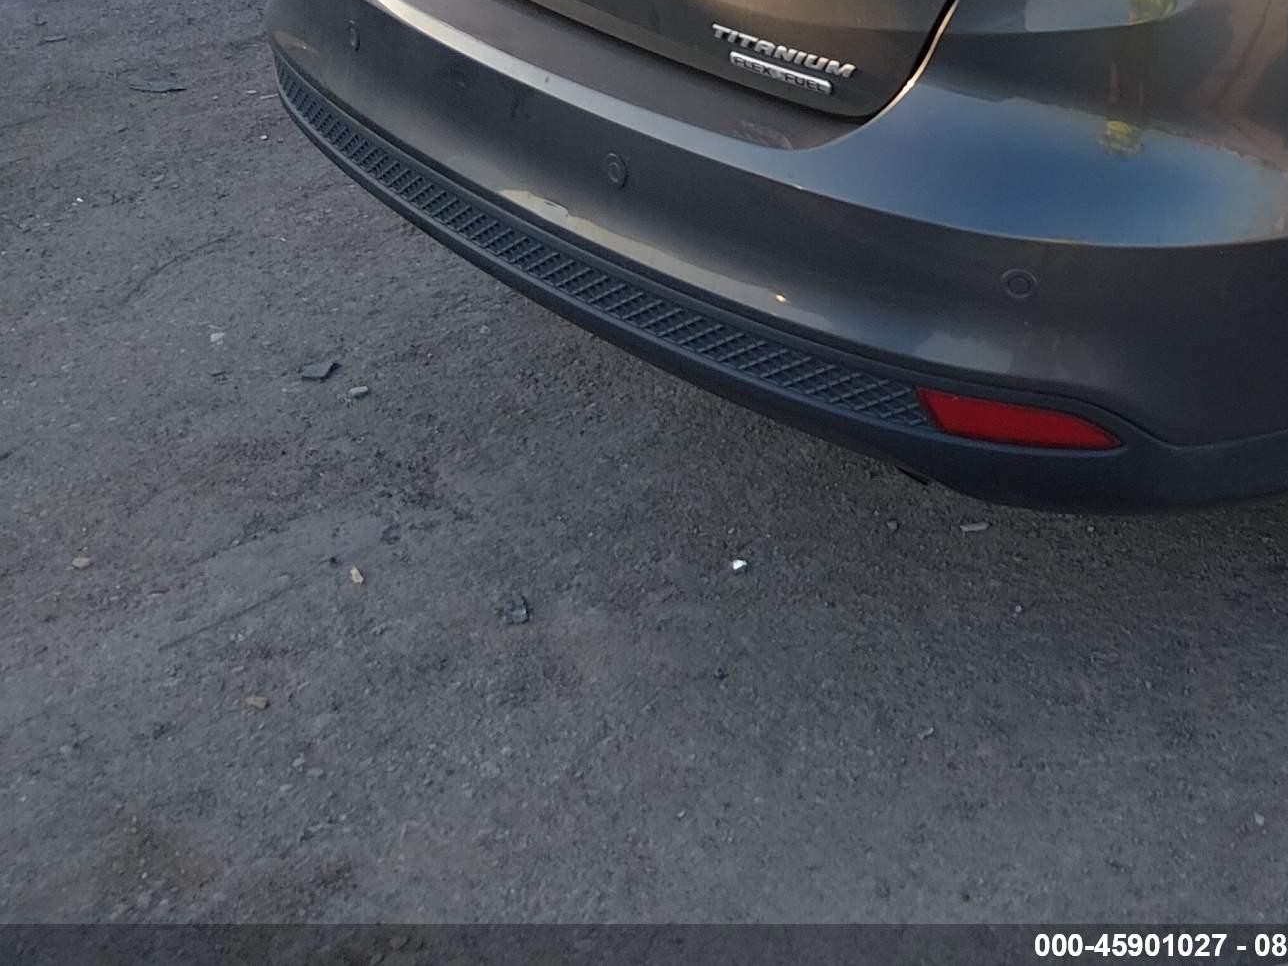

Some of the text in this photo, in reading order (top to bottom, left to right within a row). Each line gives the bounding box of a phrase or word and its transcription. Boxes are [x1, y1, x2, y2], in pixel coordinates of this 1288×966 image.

[711, 23, 857, 78] TITANIUM
[732, 56, 828, 93] FLEX FUEL
